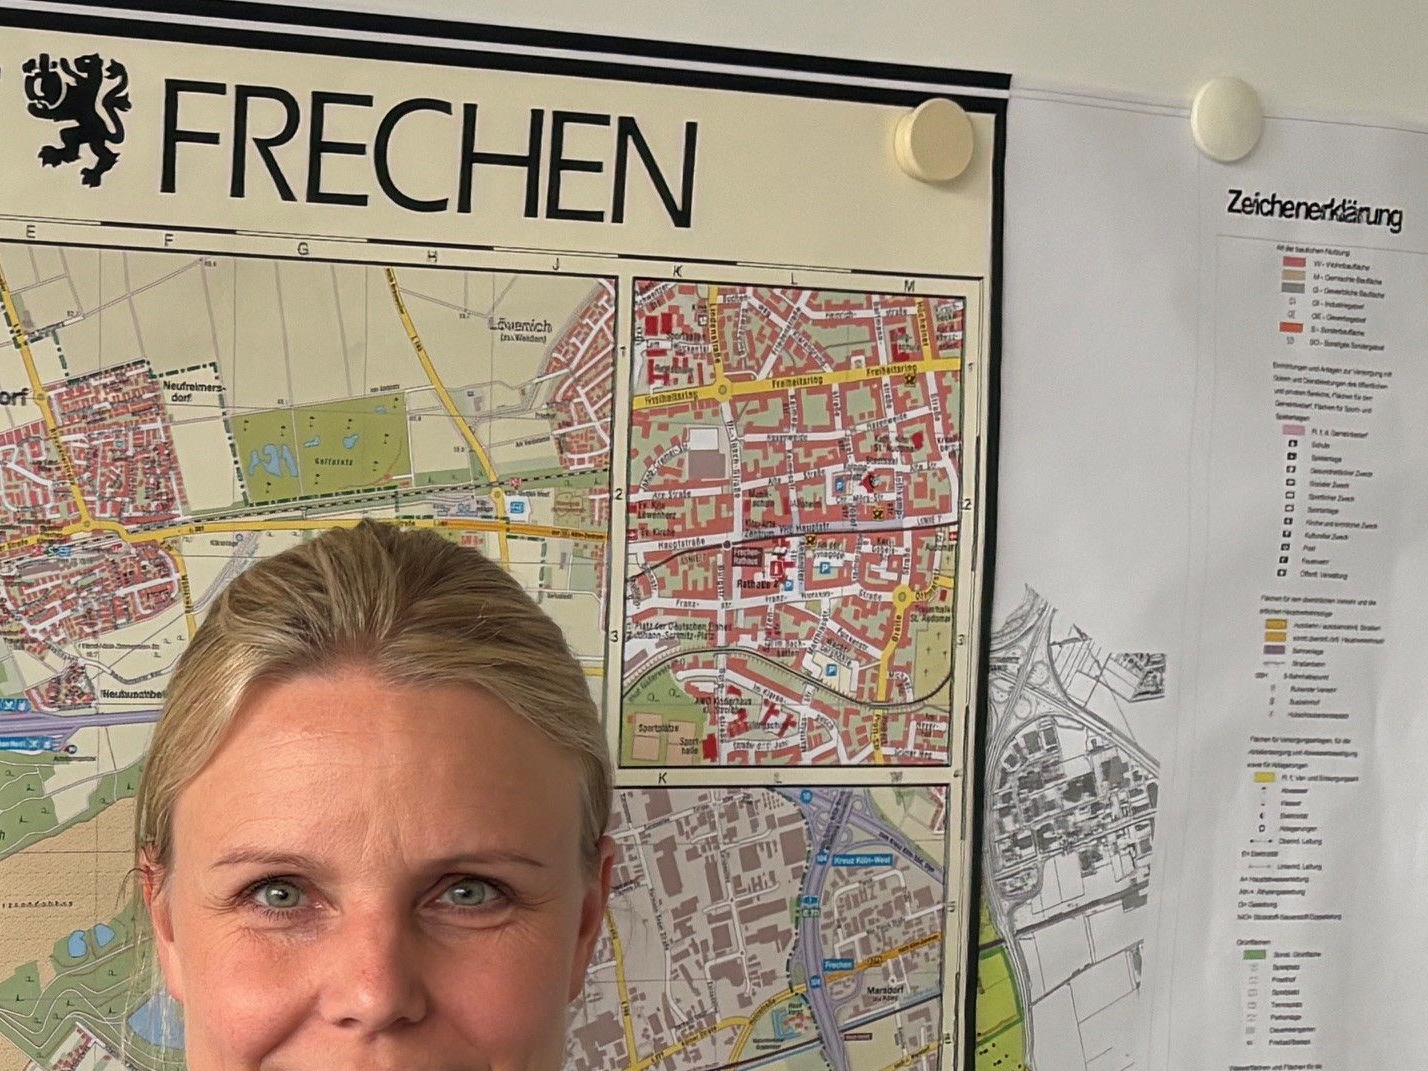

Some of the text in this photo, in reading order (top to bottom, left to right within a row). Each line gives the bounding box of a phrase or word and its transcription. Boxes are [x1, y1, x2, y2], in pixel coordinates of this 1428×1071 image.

[160, 79, 699, 229] FRECHEN
[1226, 189, 1402, 234] Zeichenerklärung
[26, 226, 35, 238] E
[165, 234, 173, 246] F
[297, 242, 309, 255] G
[659, 773, 667, 783] K
